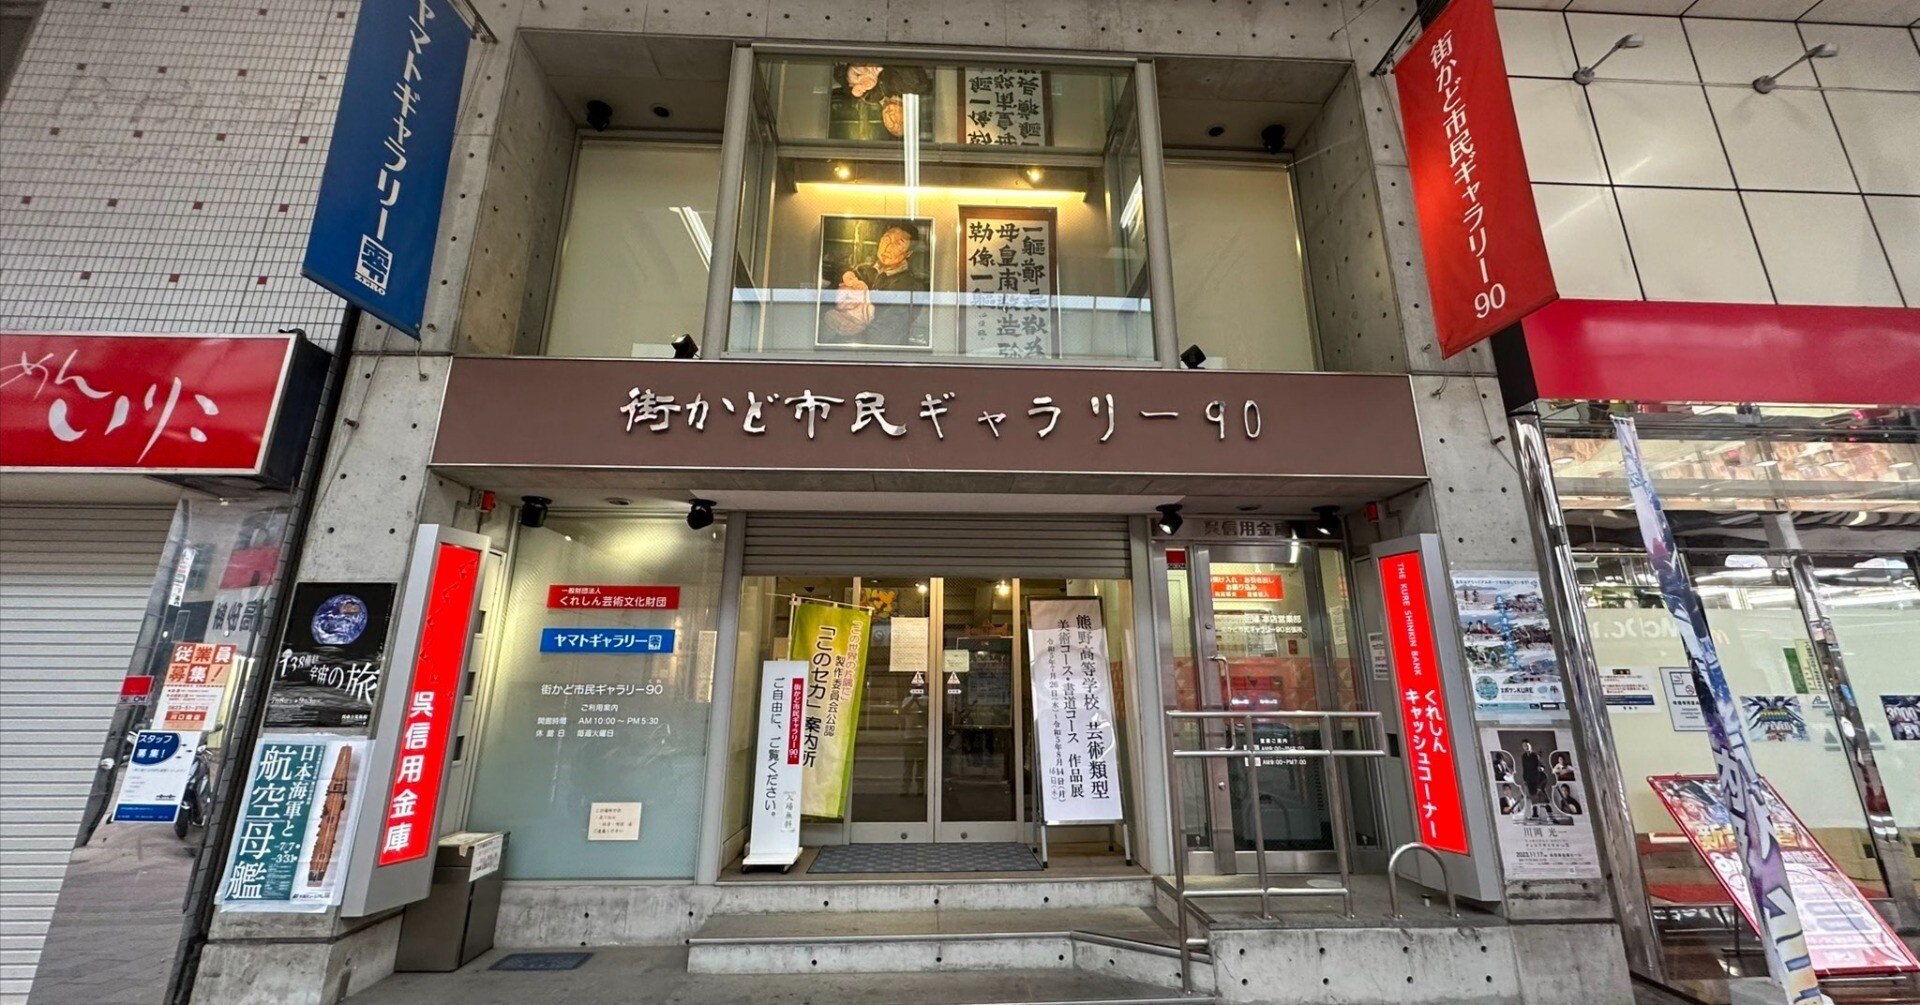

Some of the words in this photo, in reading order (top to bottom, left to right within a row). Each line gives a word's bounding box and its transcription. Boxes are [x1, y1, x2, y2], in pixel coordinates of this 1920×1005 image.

[1429, 29, 1506, 319] 街かど市民ギャラリー90
[355, 272, 386, 295] ZERO
[619, 387, 1262, 440] 街かど市民ギャラリー90
[1397, 563, 1406, 579] THE
[1401, 583, 1411, 606] KURE
[559, 596, 667, 608] くれしん芸術文化財団
[1404, 610, 1418, 647] SHINKIN
[174, 645, 234, 664] 従業員
[1075, 614, 1101, 710] 熊野高等学校
[1412, 650, 1422, 676] BANK
[310, 663, 380, 706] 宇宙の旅
[541, 684, 663, 695] 街かど市民ギャラリー90
[824, 655, 845, 736] 製作委員会公認
[1057, 619, 1080, 744] 美術コース・書道コース
[138, 734, 173, 743] スタッフ
[578, 716, 592, 725] AM
[627, 716, 641, 725] PM
[1425, 689, 1447, 754] くれしん
[764, 677, 785, 818] ご自由に、ご覧ください。
[1086, 721, 1110, 800] 芸術類型
[1406, 688, 1438, 838] キャッシュコーナー
[281, 745, 315, 837] 日本海軍と
[382, 691, 435, 855] 呉信用金庫
[1068, 753, 1085, 799] 作品展
[225, 745, 297, 899] 航空母艦
